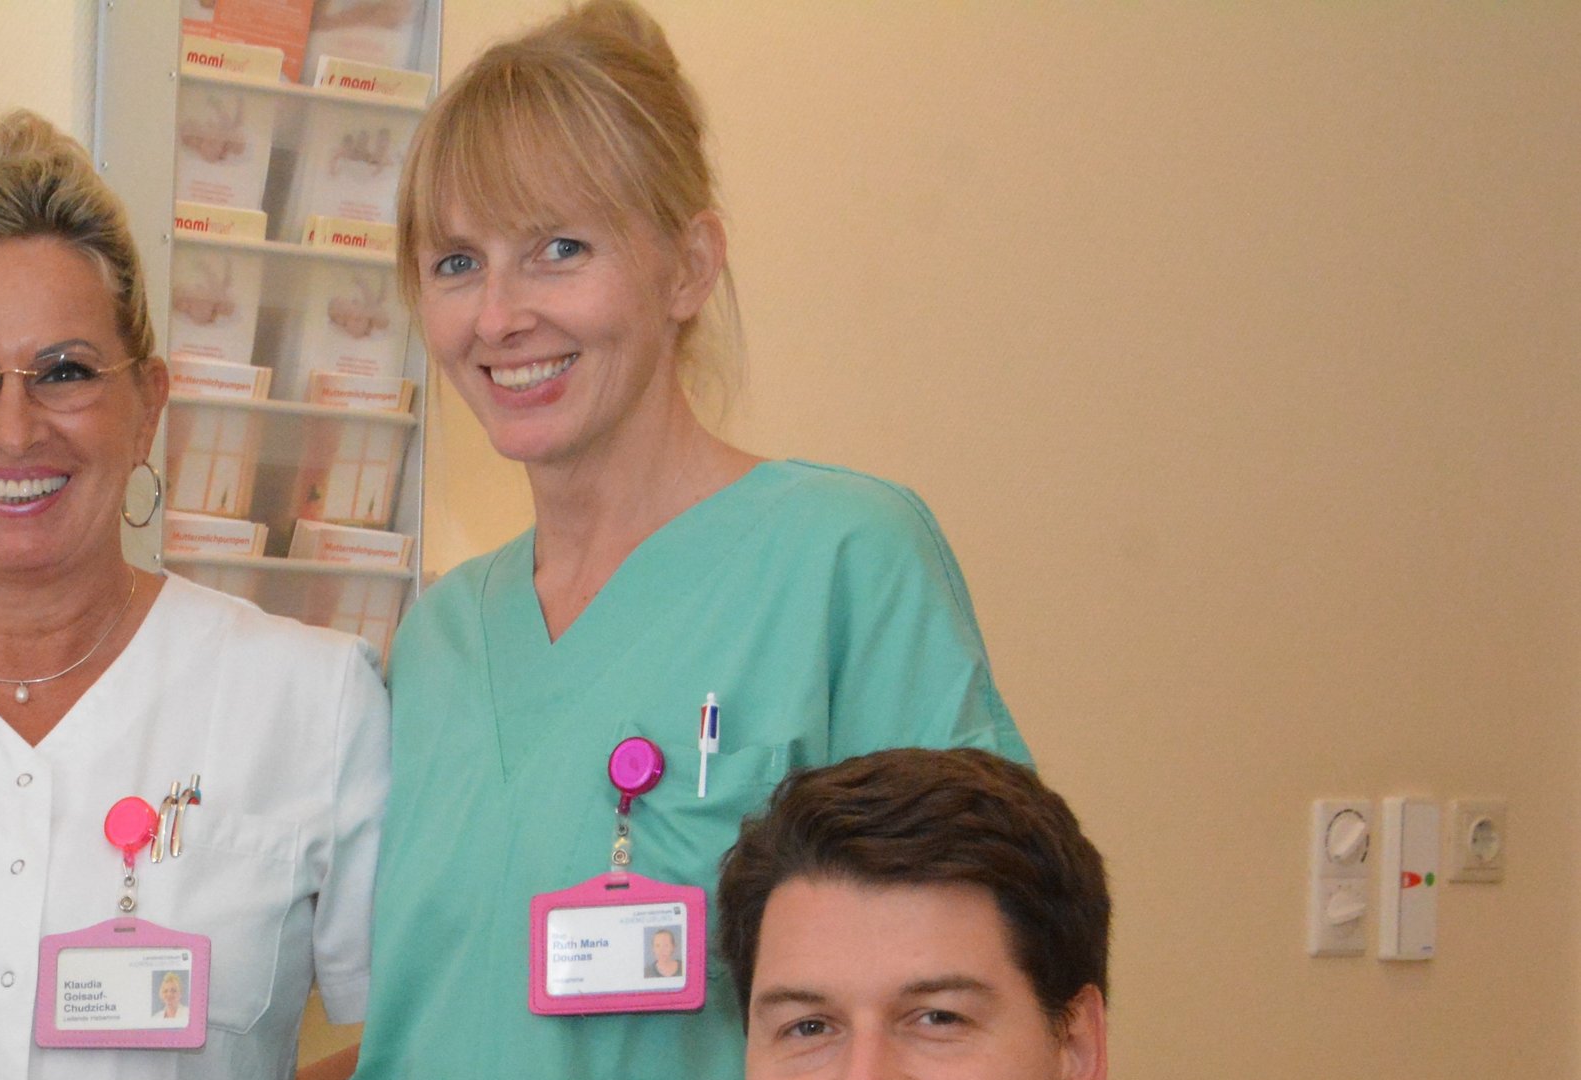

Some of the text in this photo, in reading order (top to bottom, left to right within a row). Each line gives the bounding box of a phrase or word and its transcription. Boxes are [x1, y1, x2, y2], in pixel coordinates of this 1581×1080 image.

[173, 375, 251, 392] Muttermilchpumpen
[322, 387, 398, 401] Muttermilchpumpen
[172, 531, 250, 546] Muttermilchpumpen
[324, 541, 398, 558] Muttermilchpumpen
[580, 938, 609, 949] Maria
[64, 980, 102, 990] Klaudia
[64, 991, 107, 1002] Goisauf-
[64, 1003, 117, 1013] Chudzicka
